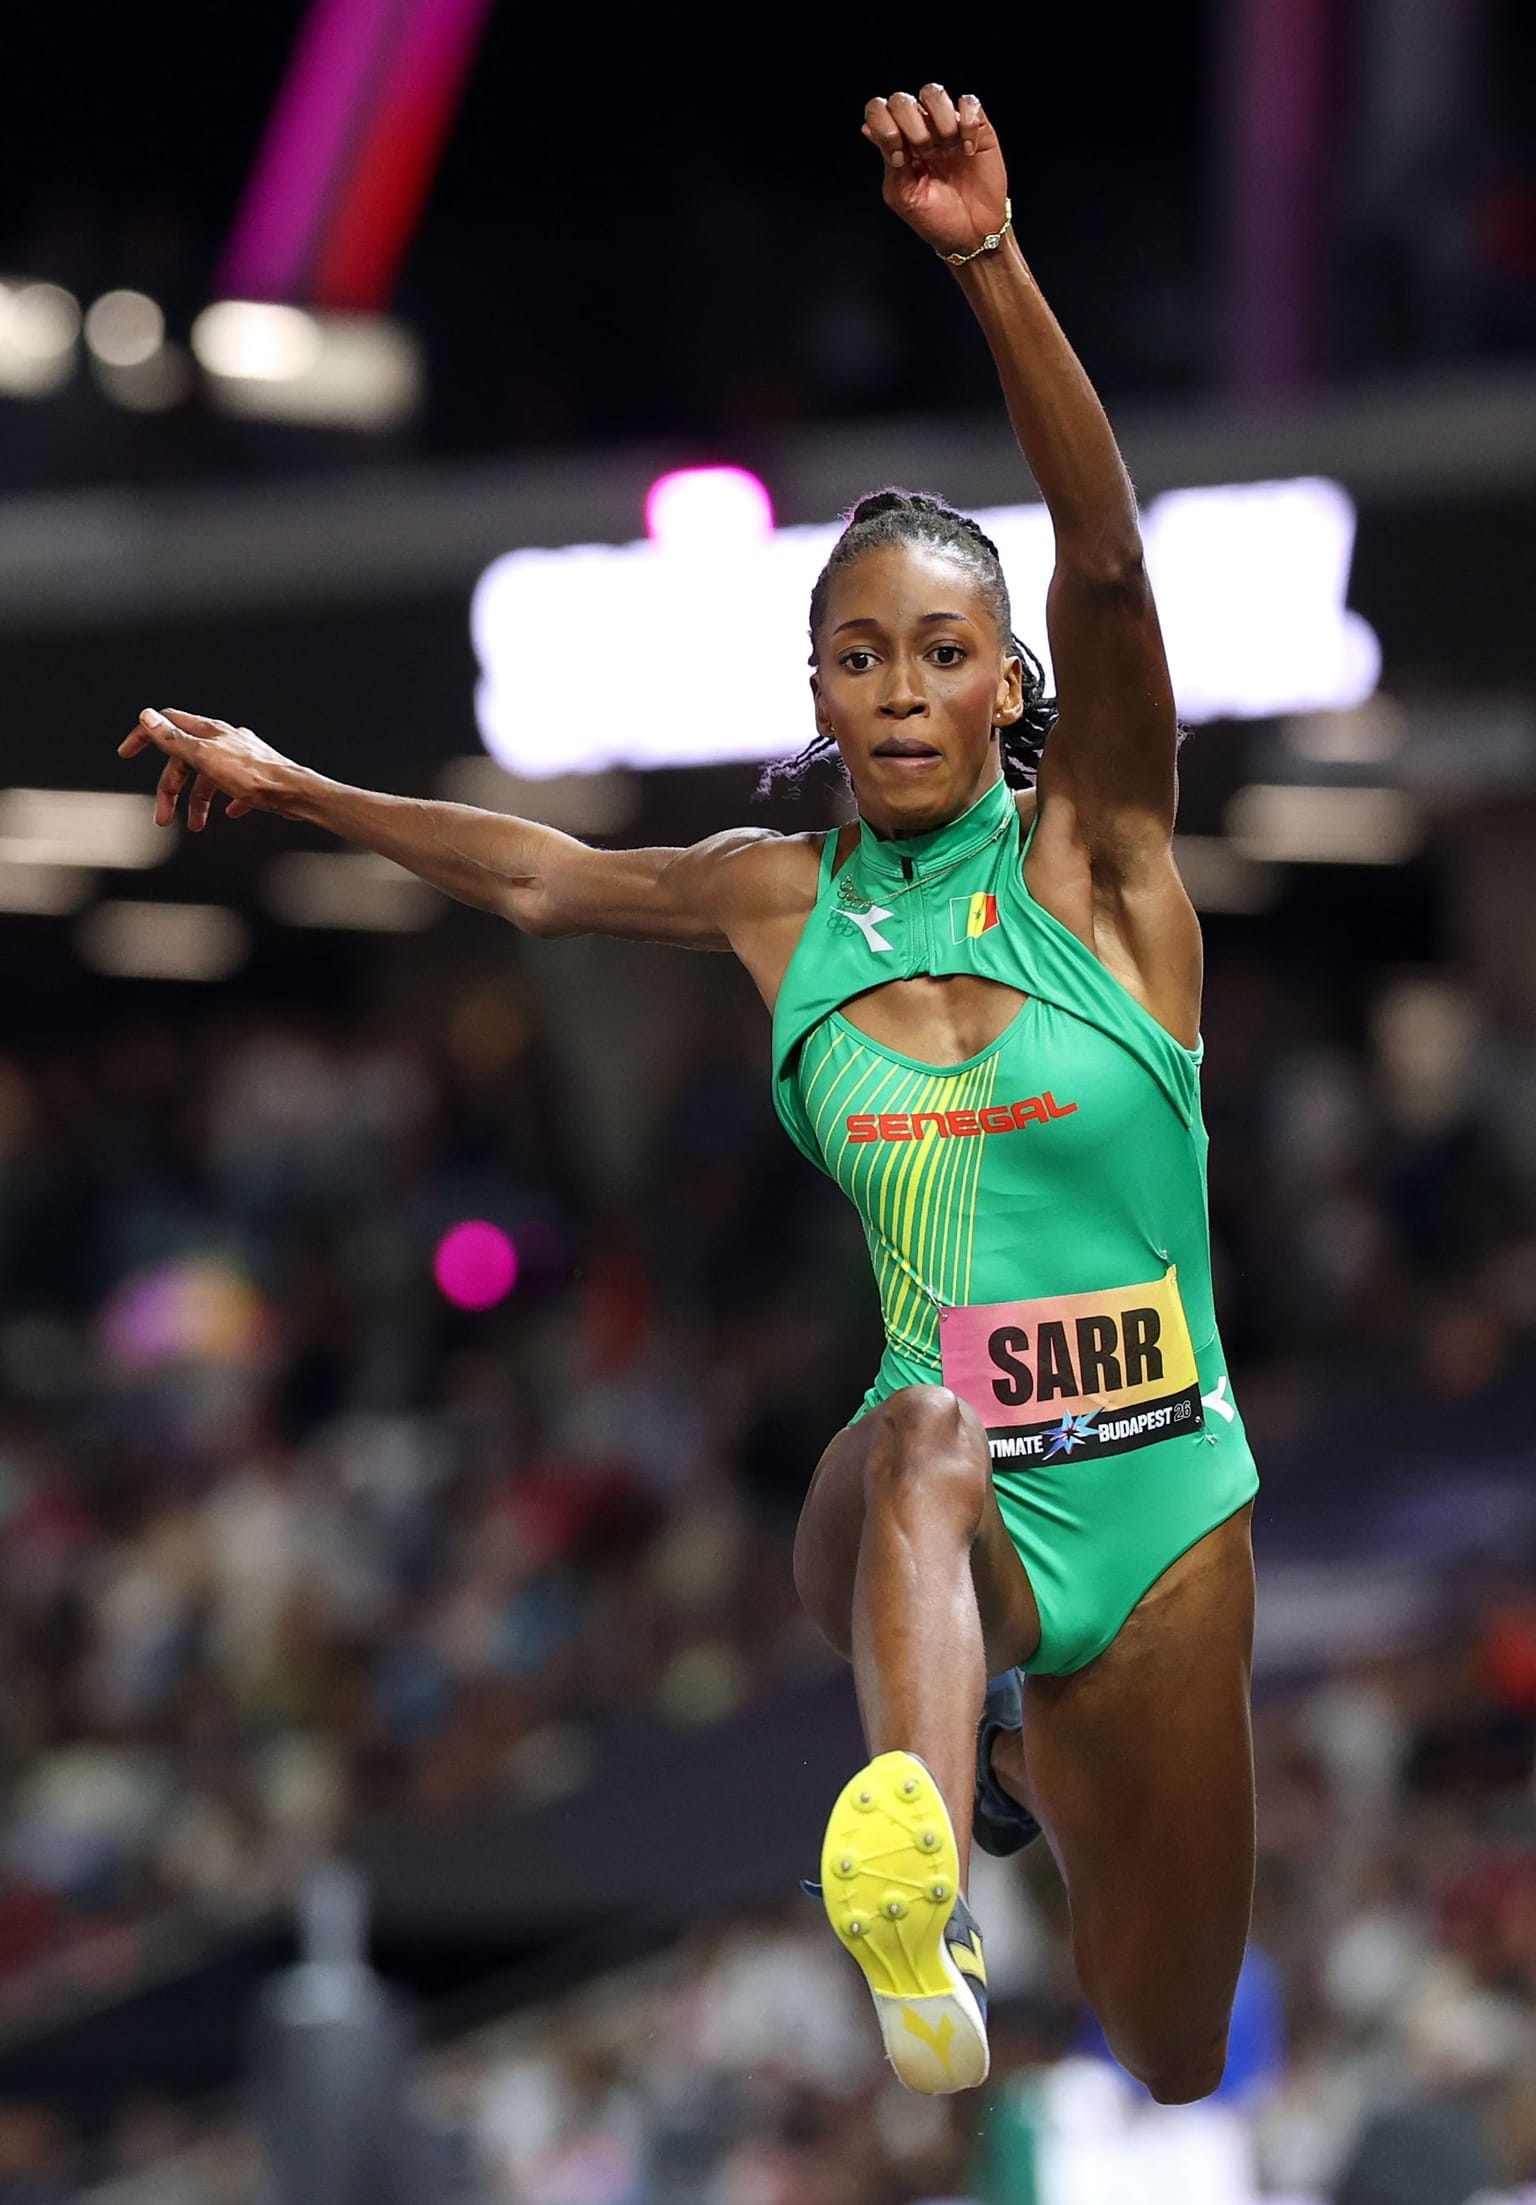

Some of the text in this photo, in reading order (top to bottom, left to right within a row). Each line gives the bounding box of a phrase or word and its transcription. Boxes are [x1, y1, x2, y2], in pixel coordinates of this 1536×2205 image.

[847, 1092, 1078, 1144] SENEGAL
[988, 1308, 1164, 1406] SARR
[988, 1400, 1192, 1458] TIMATE BUDAPEST 26
